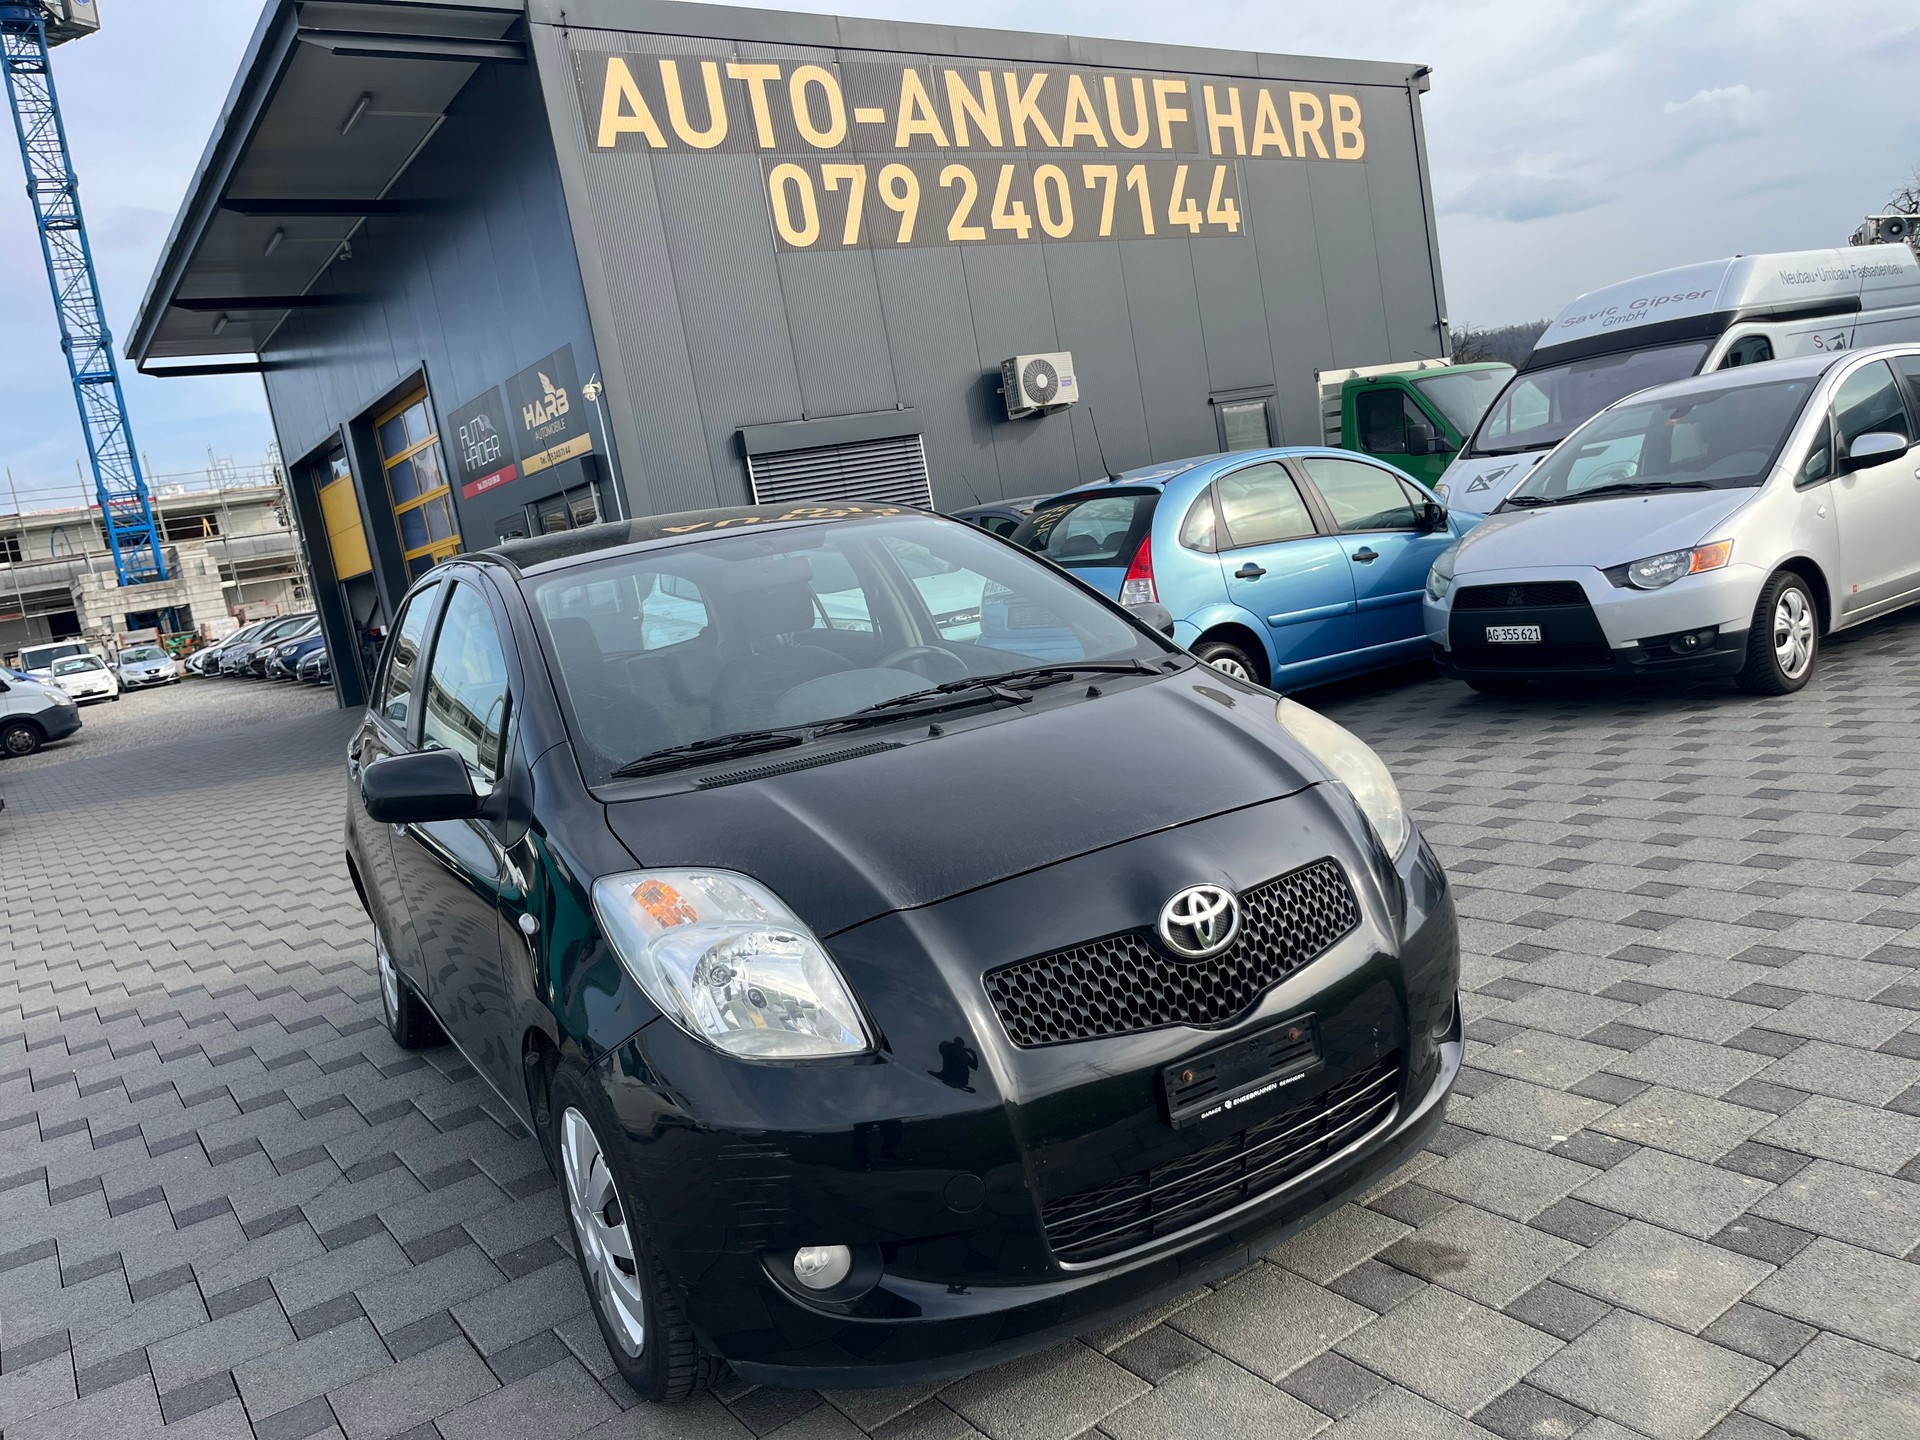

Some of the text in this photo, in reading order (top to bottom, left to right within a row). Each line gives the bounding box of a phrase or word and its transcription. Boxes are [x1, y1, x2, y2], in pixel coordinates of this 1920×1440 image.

[599, 58, 1366, 160] AUTO-ANKAUF HARB
[771, 163, 1241, 248] 079 240 71 44
[1561, 289, 1713, 328] Savic Gipser
[1602, 309, 1649, 327] GmbH
[522, 387, 569, 430] HARB
